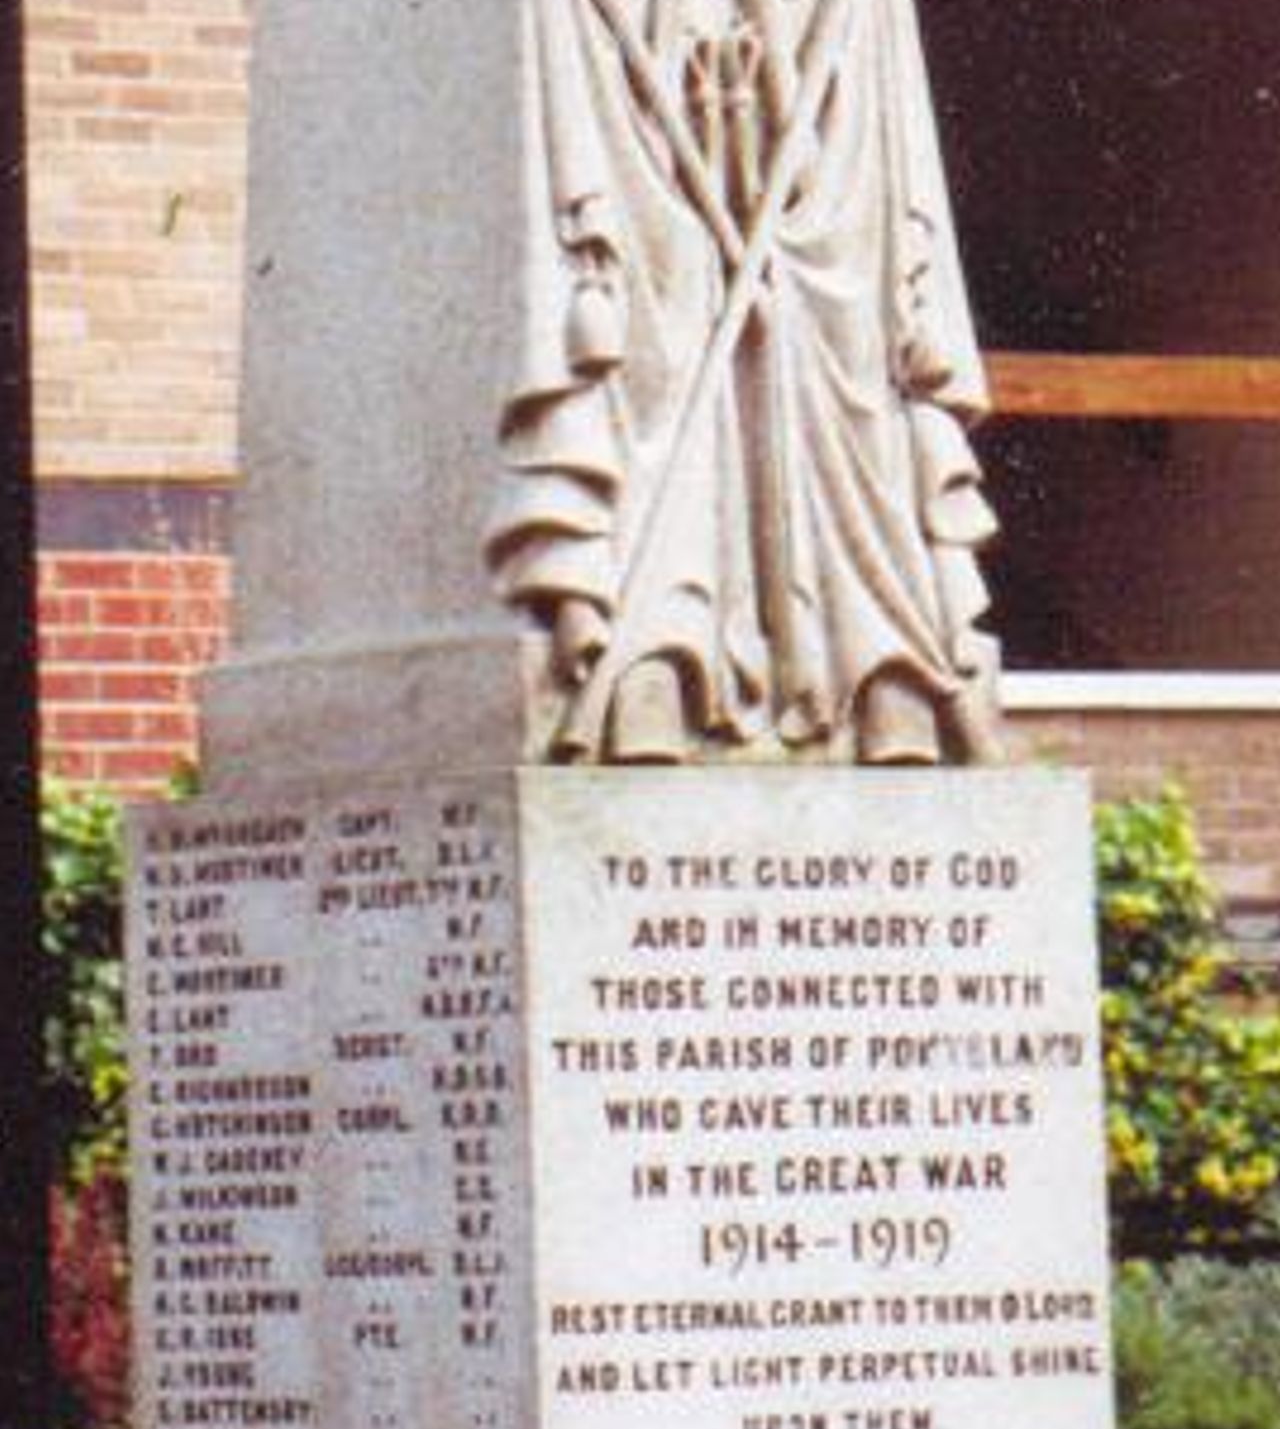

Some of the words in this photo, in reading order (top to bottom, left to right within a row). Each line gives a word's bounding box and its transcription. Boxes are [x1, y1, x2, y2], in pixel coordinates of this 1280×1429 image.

[604, 856, 648, 887] TO
[668, 856, 737, 887] THE
[890, 856, 930, 888] OF
[633, 916, 706, 948] AND
[724, 916, 758, 948] IN
[778, 915, 930, 948] MEMORY
[949, 916, 988, 948] OF
[591, 977, 707, 1010] THOSE
[727, 975, 940, 1009] CONNECTED
[956, 974, 1044, 1008] WITH
[553, 1040, 638, 1072] THIS
[657, 1037, 793, 1070] PARISH
[809, 1037, 850, 1068] OF
[604, 1100, 682, 1132] WHO
[699, 1097, 792, 1130] GAVE
[810, 1095, 910, 1129] THEIR
[931, 1093, 1032, 1128] LIVES
[633, 1166, 668, 1198] IN
[688, 1163, 757, 1196] THE
[776, 1157, 899, 1194] GREAT
[924, 1154, 1006, 1190] WAR
[551, 1304, 625, 1334] REST
[634, 1302, 764, 1333] ETERNAL
[875, 1298, 907, 1325] TO
[915, 1295, 992, 1324] THEM
[557, 1361, 620, 1392] AND
[632, 1360, 696, 1391] LET
[820, 1351, 995, 1383] PERPETUAL
[1011, 1348, 1100, 1378] SHINE
